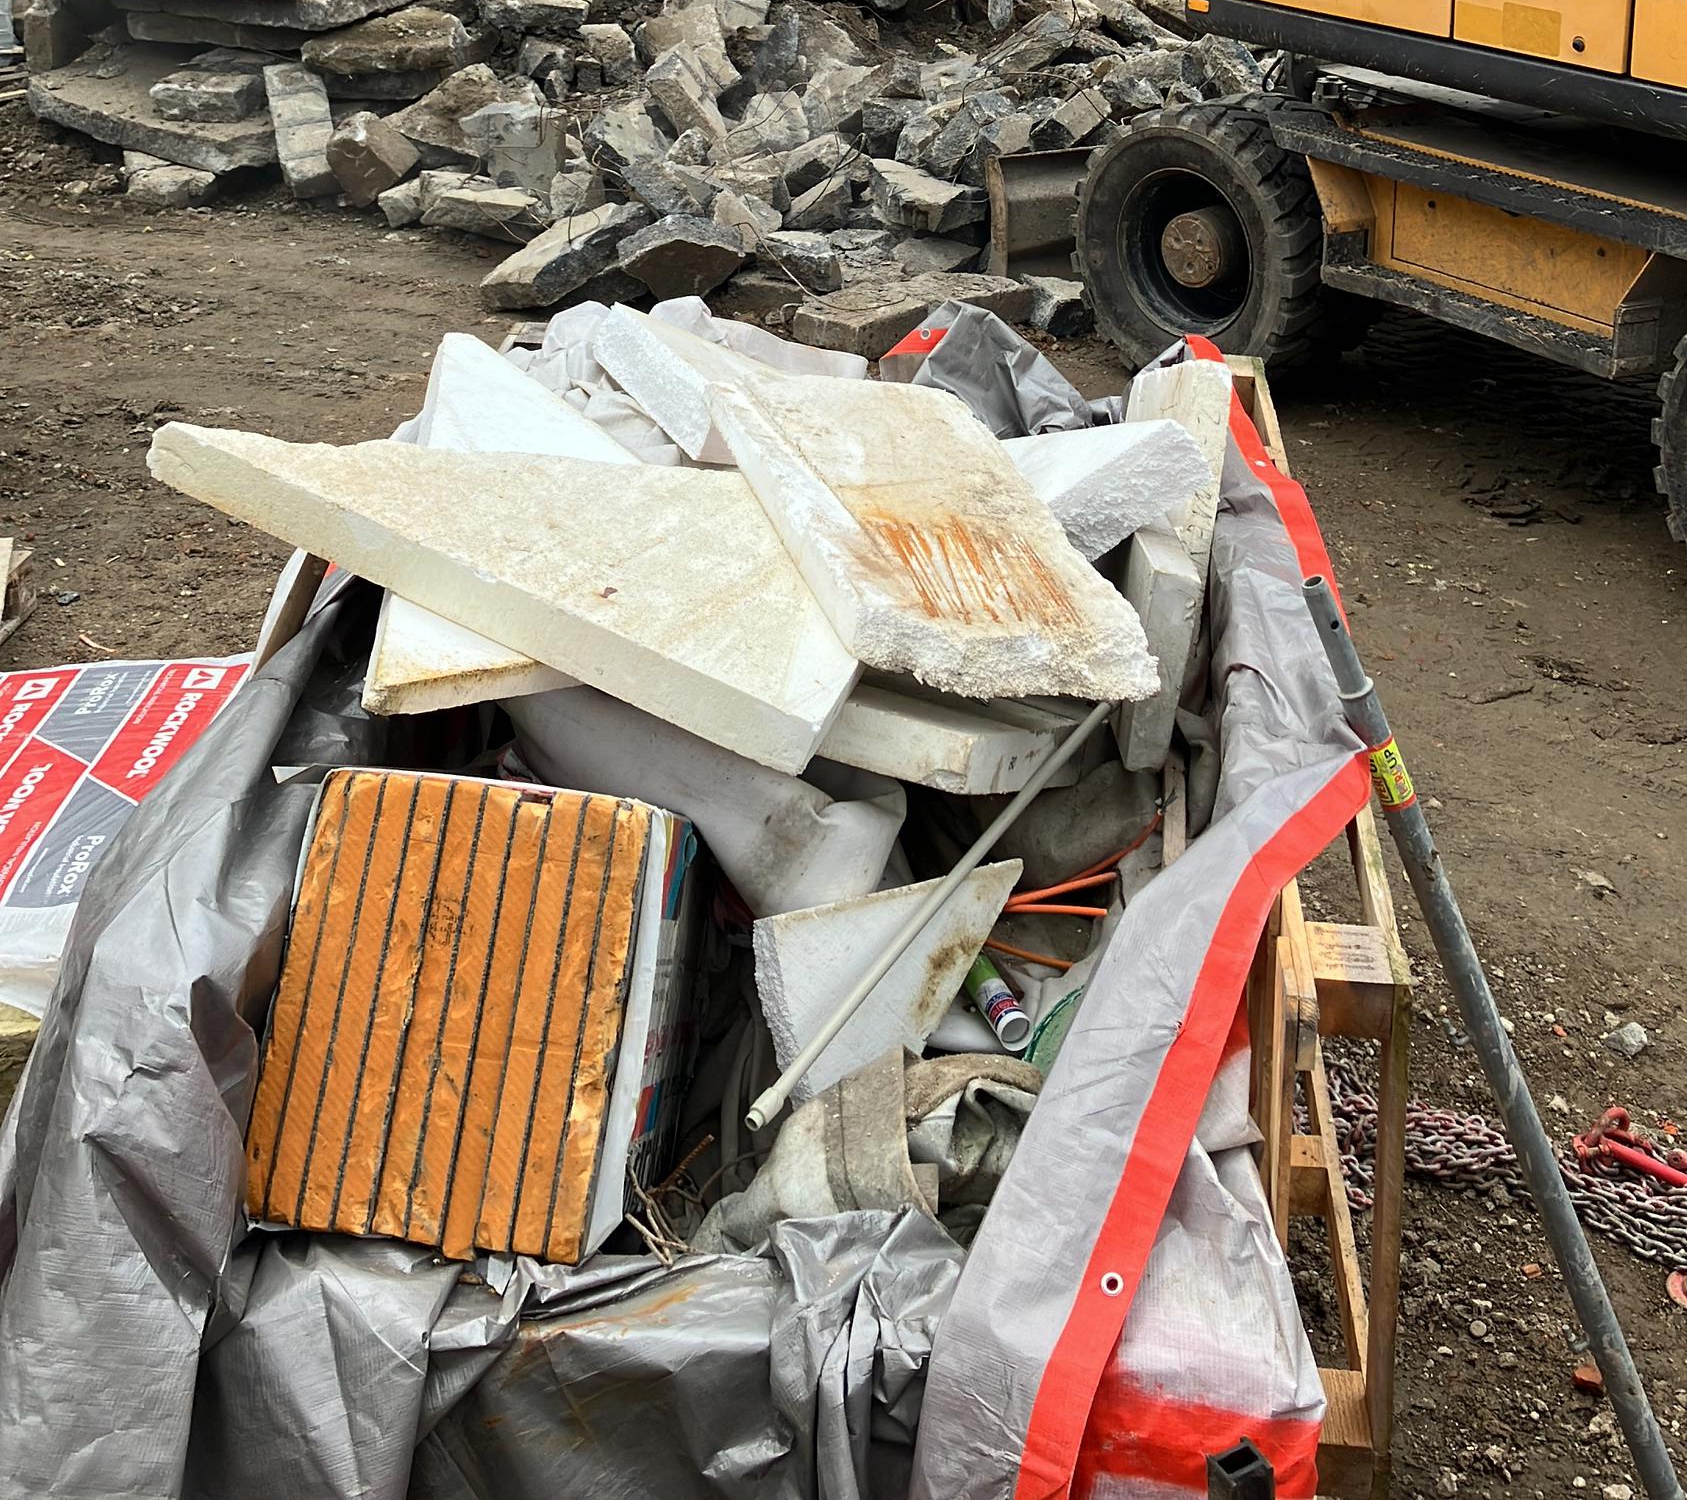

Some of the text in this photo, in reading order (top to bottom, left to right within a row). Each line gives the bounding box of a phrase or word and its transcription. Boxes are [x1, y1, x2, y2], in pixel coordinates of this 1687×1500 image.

[74, 672, 119, 715] ProRox
[125, 692, 204, 779] ROCKWOOL
[56, 835, 106, 896] ProRox
